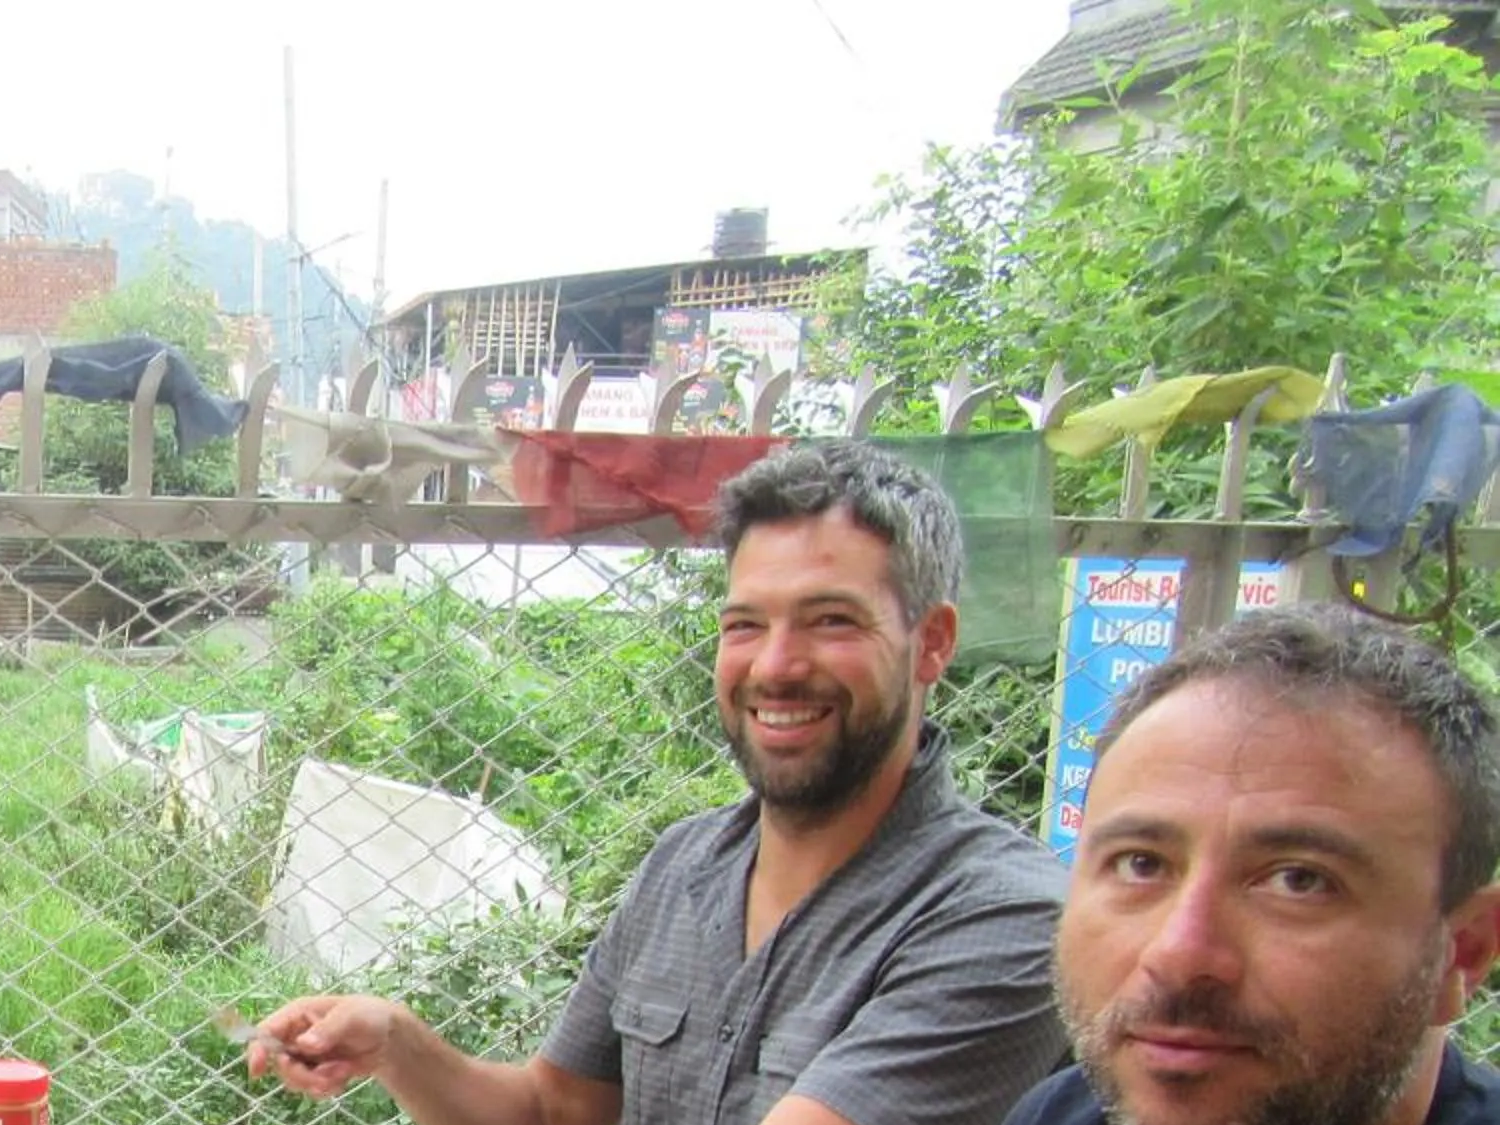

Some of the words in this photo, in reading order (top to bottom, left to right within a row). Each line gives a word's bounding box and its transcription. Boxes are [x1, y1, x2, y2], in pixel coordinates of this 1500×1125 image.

[1088, 575, 1151, 602] Tourist
[1091, 617, 1172, 648] LUMBI
[1060, 805, 1084, 830] Da
